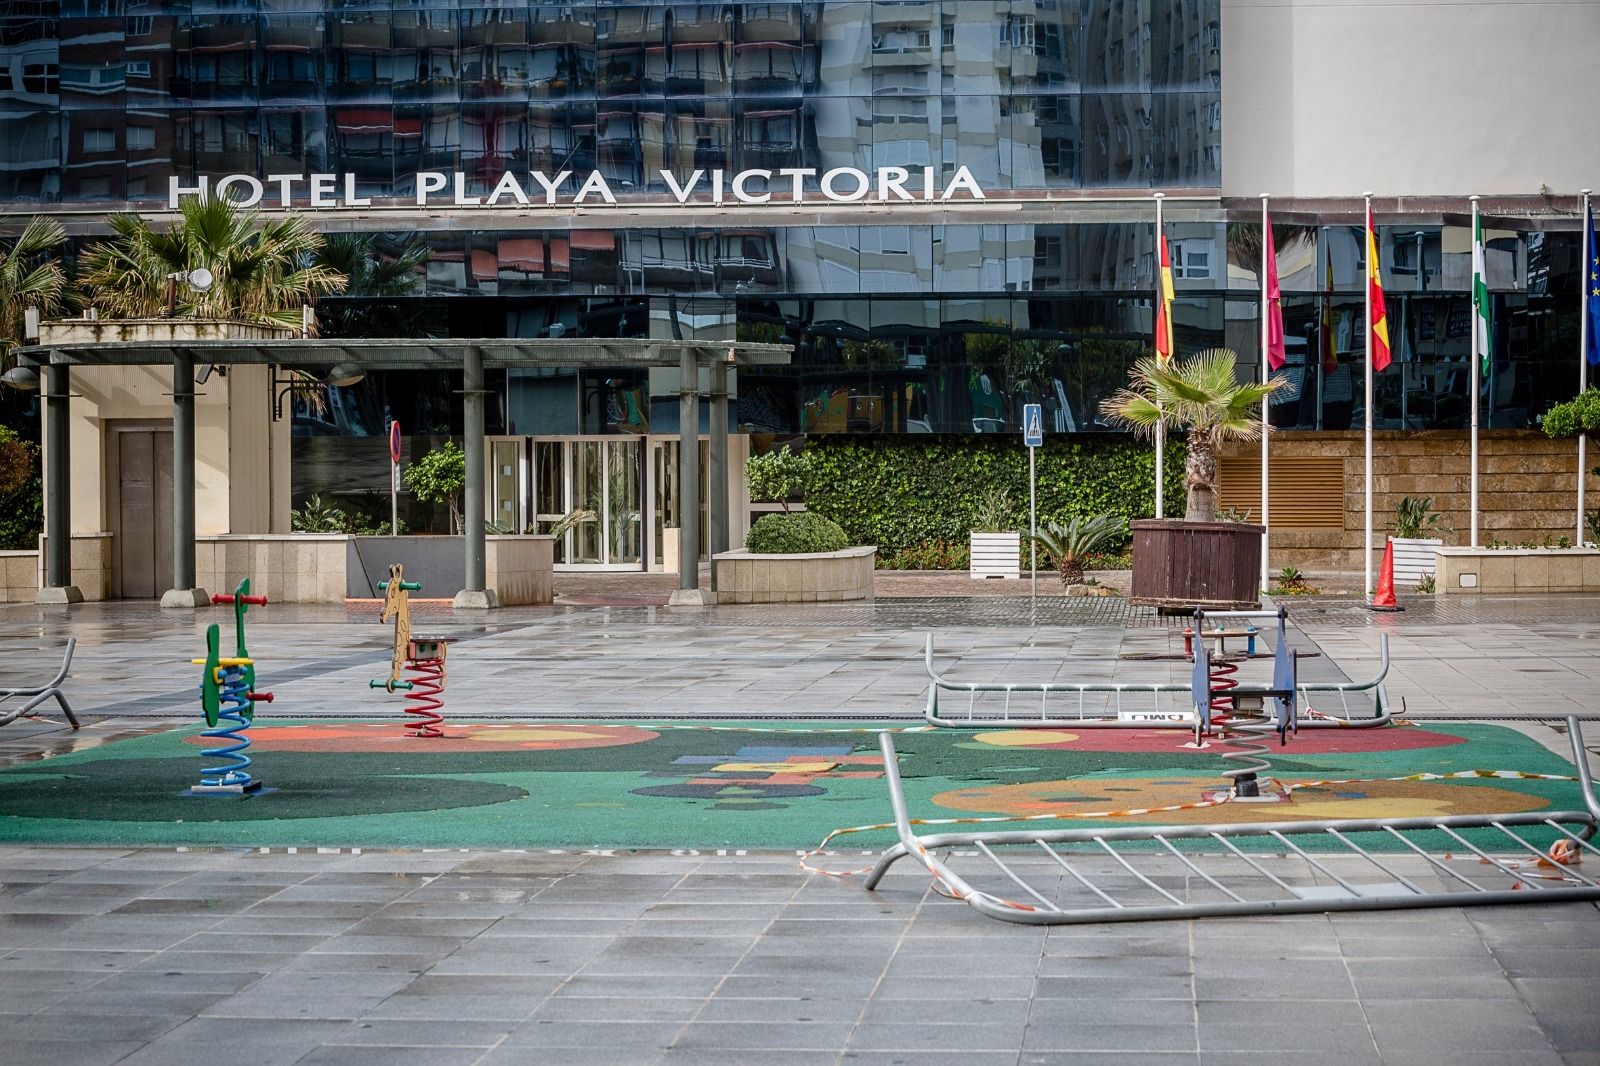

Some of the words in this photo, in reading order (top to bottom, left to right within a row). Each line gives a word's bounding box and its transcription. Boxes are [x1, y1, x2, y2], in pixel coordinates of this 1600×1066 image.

[169, 172, 371, 208] HOTEL
[416, 169, 617, 206] PLAYA
[660, 165, 986, 204] VICTORIA
